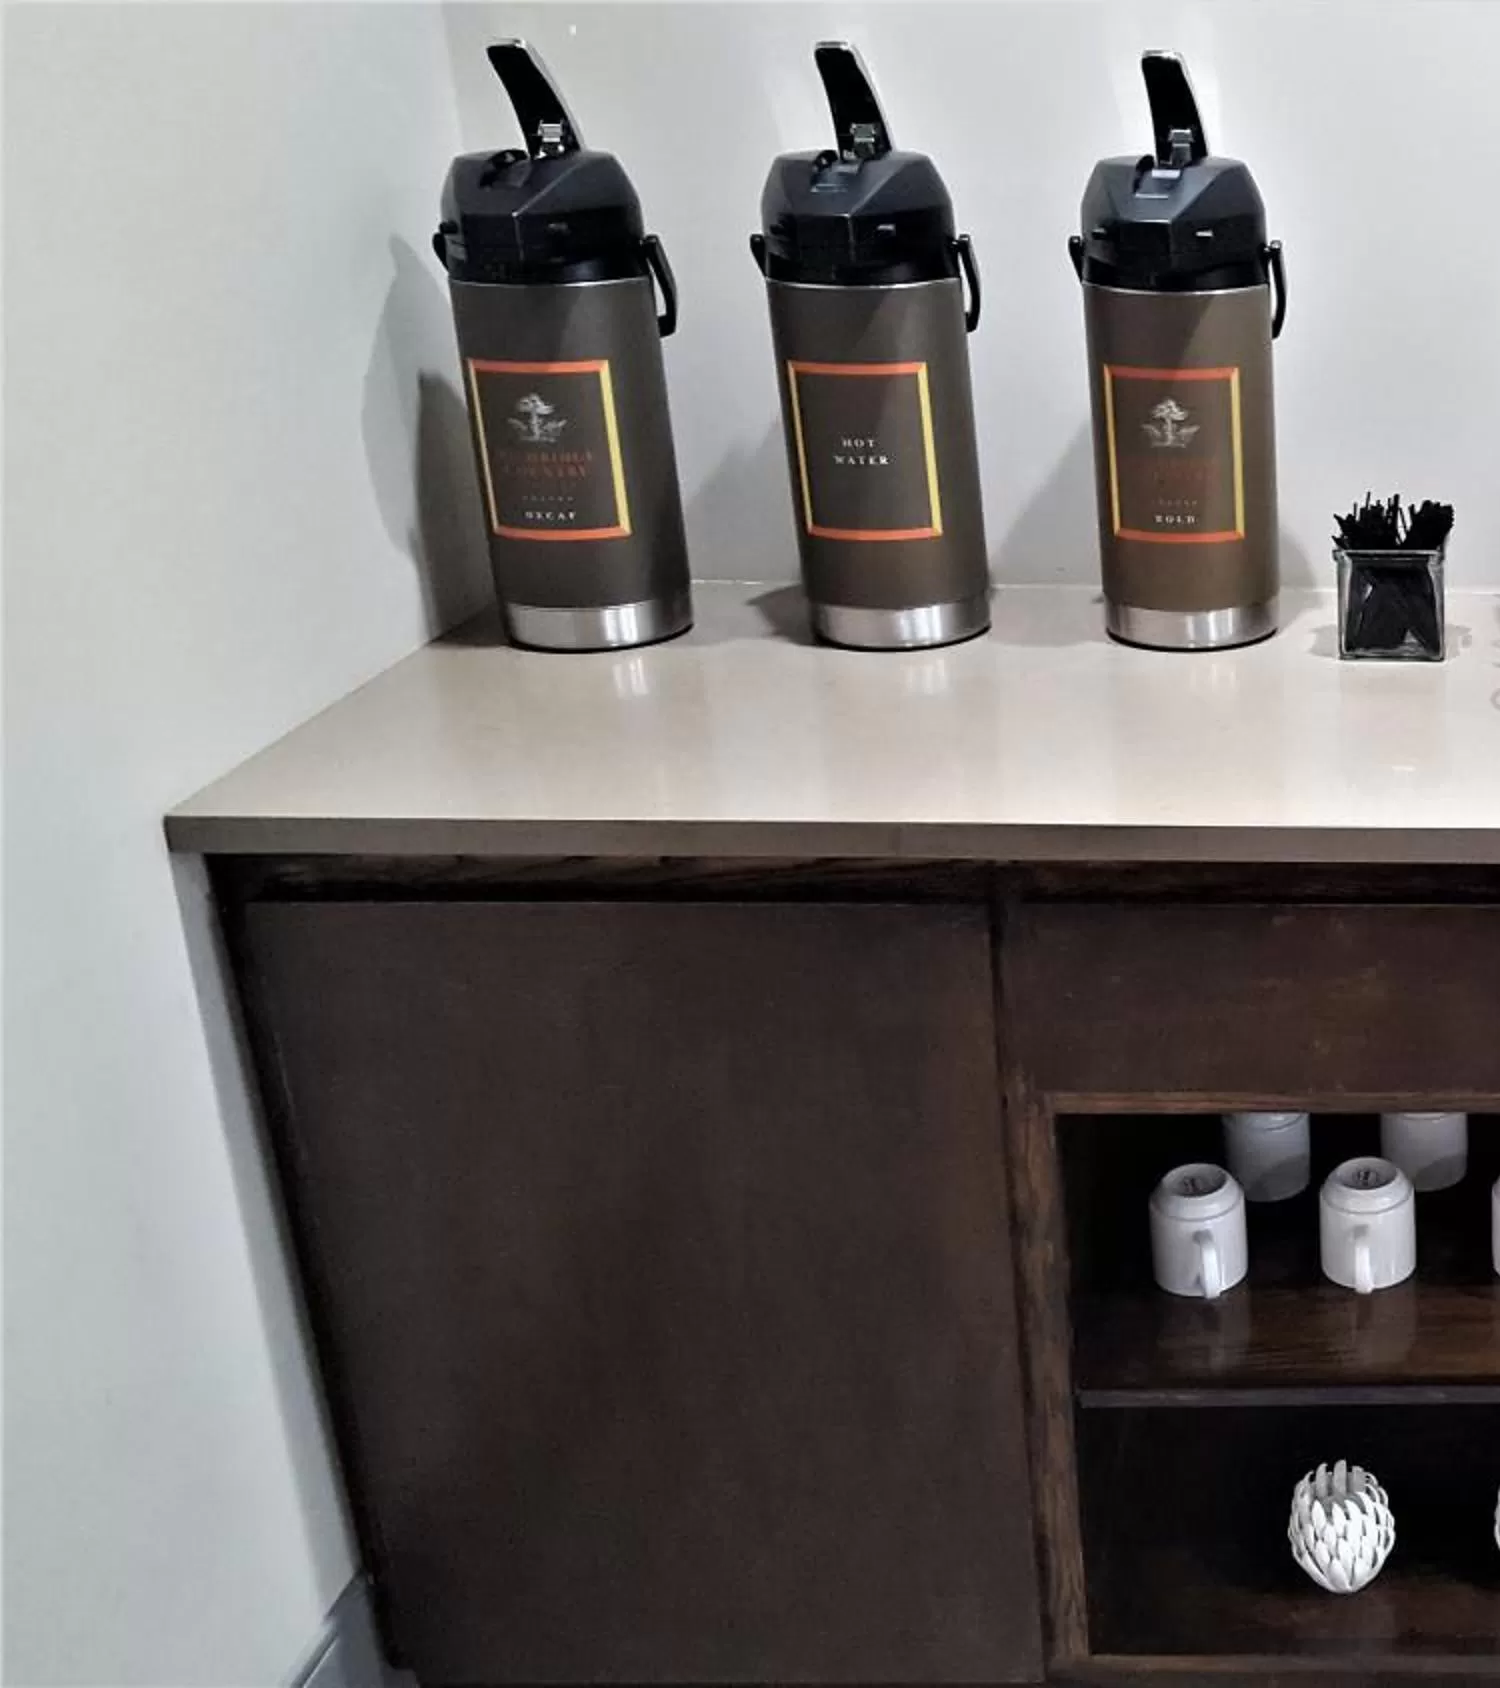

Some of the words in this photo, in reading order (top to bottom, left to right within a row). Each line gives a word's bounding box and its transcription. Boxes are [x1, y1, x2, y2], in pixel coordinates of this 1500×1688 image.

[842, 438, 875, 448] HOT
[833, 455, 889, 465] WATER
[525, 511, 576, 521] DECAF
[1155, 514, 1197, 525] BOLD
